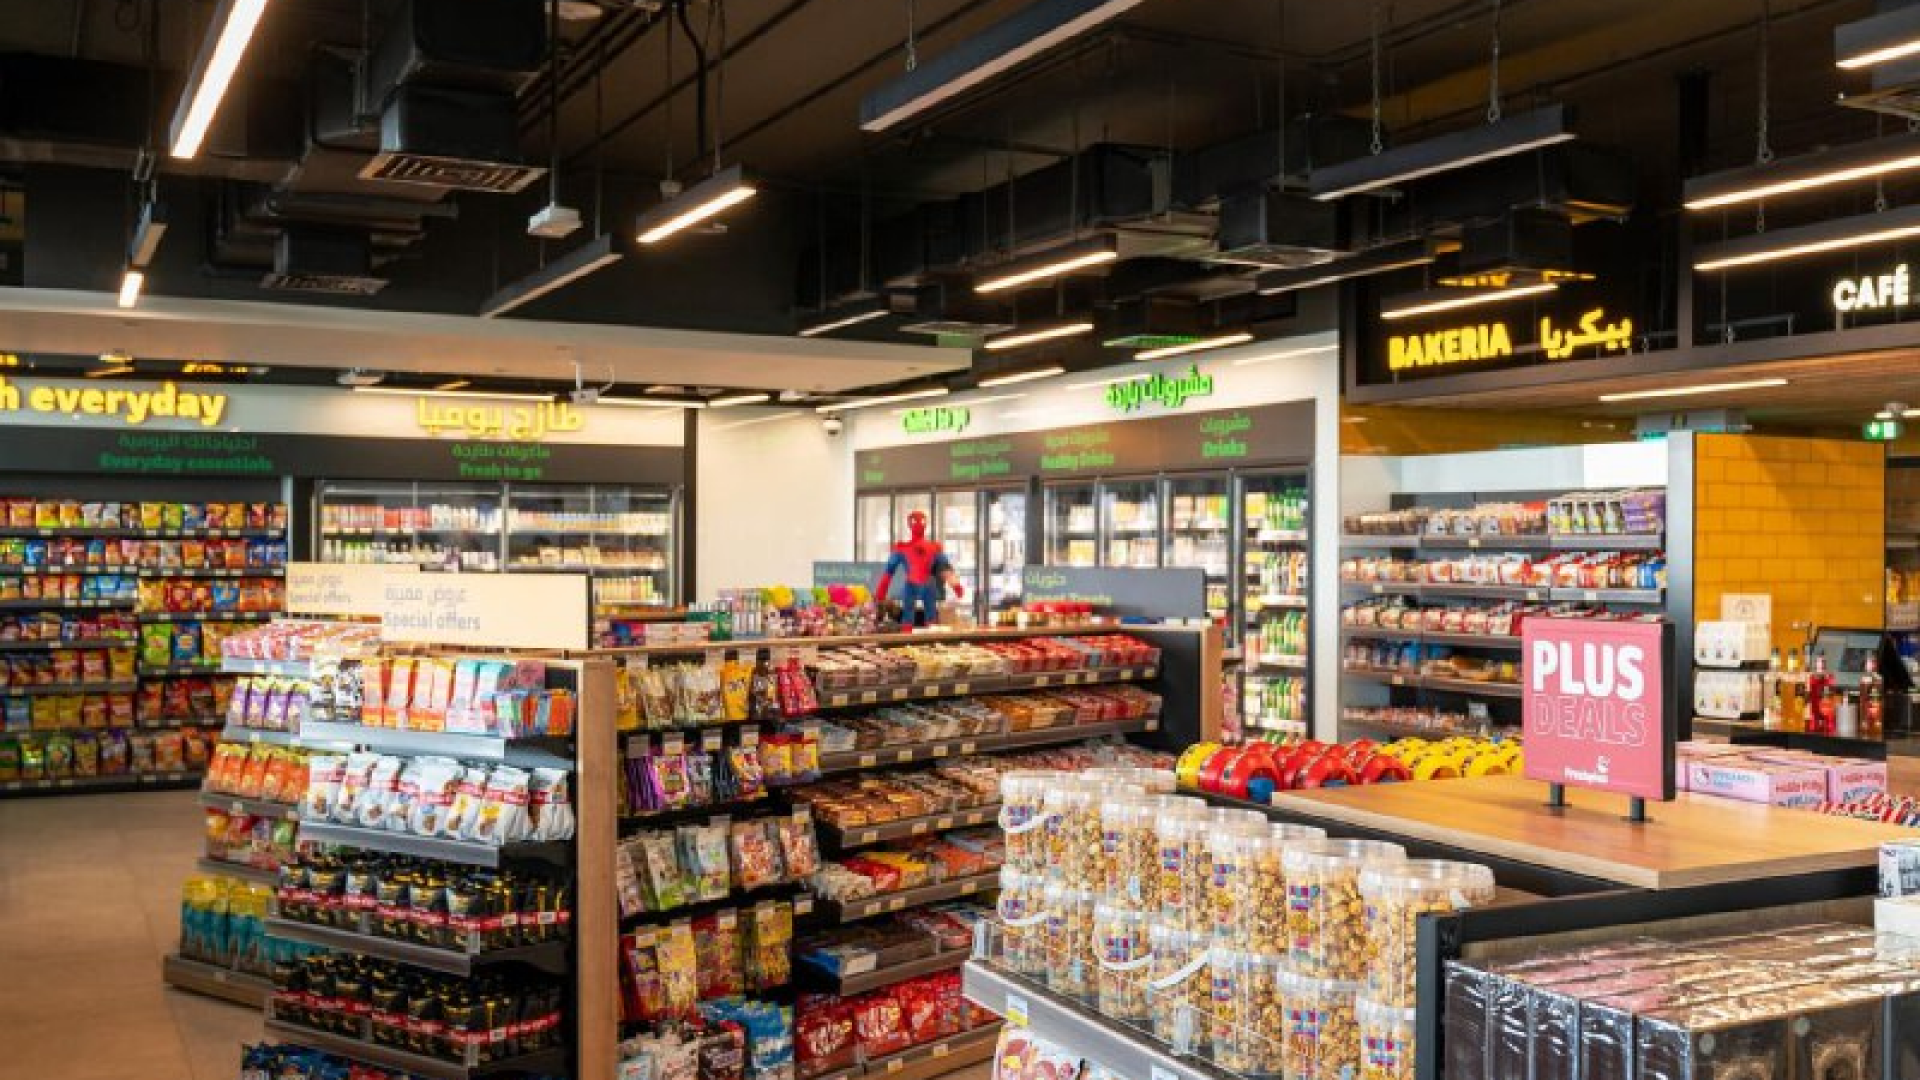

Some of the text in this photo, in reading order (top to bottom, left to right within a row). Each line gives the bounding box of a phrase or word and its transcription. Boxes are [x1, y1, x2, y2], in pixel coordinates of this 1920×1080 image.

[1833, 263, 1909, 312] CAFÉ
[1389, 322, 1512, 371] BAKERIA
[1540, 307, 1632, 359] بيكريا
[30, 381, 227, 426] everyday
[509, 401, 584, 440] طازج
[383, 610, 481, 632] Special offers
[1533, 640, 1645, 701] PLUS
[1533, 693, 1647, 747] DEALS
